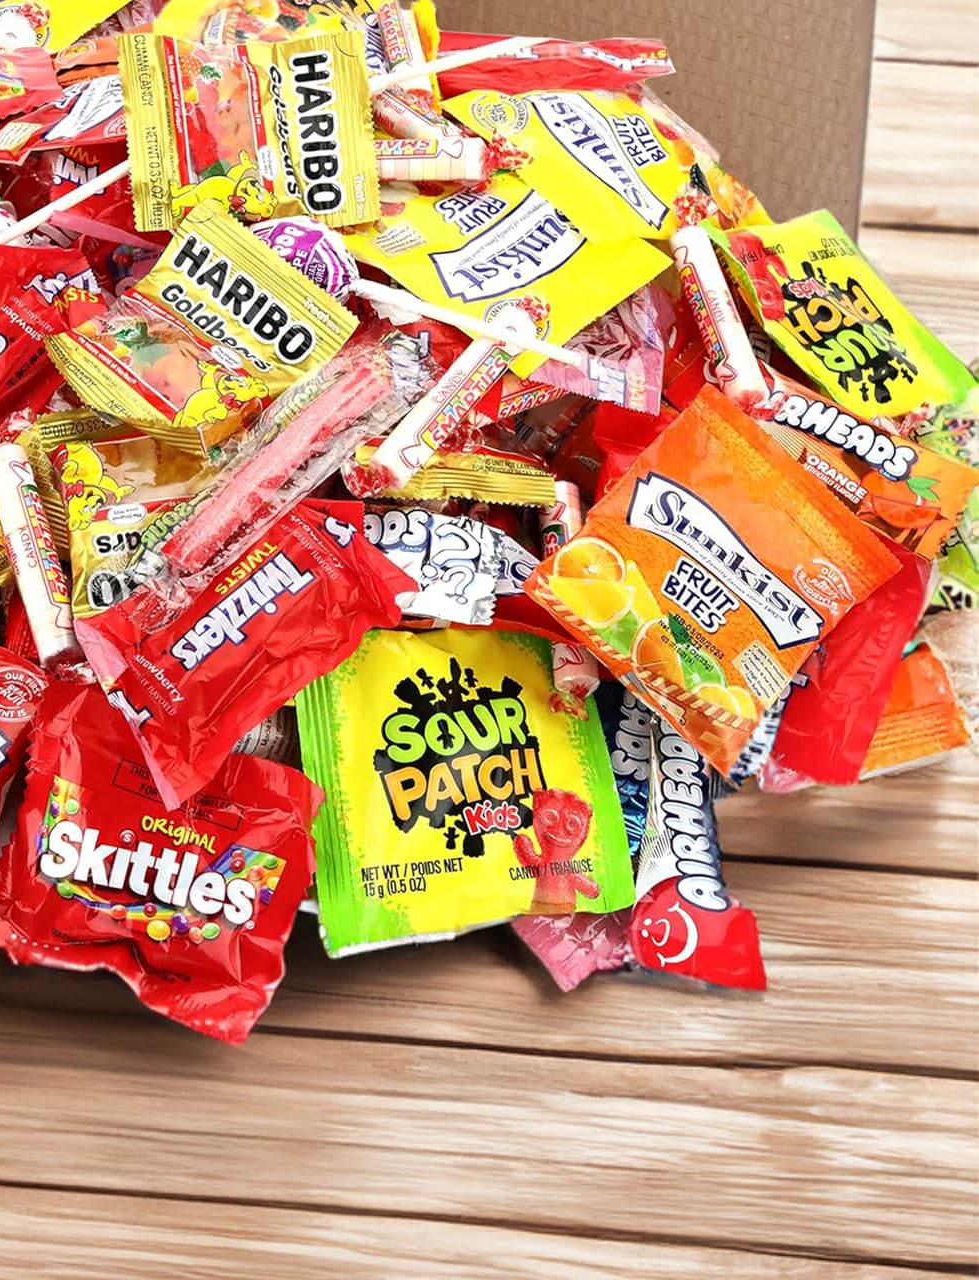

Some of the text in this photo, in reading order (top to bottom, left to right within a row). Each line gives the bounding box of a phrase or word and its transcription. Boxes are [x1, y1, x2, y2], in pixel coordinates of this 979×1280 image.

[379, 3, 402, 63] SMARTIES
[138, 73, 153, 106] CANDY
[291, 53, 342, 213] HARIBO
[375, 139, 431, 151] SMAR
[535, 93, 651, 211] Sunkist
[613, 116, 646, 166] FRUIT
[626, 116, 667, 163] BITES
[457, 195, 507, 234] FRUIT
[172, 234, 315, 361] HARIBO
[303, 297, 328, 321] Treat
[784, 284, 883, 346] PATCH
[161, 282, 273, 371] Goldbears
[430, 355, 509, 444] SMARTIES
[431, 367, 467, 406] CANDY
[806, 454, 869, 499] ORANGE
[832, 482, 861, 505] FLAVORED
[19, 526, 39, 569] CANDY
[28, 491, 69, 597] SMARTIES
[214, 540, 278, 595] TWISTS
[646, 489, 810, 634] Sunkist
[676, 558, 735, 612] FRUIT
[821, 566, 839, 582] OUR
[171, 550, 315, 671] Twizzlers
[663, 574, 722, 630] BITES
[4, 672, 42, 698] OUR FIRST
[5, 683, 28, 697] REAL
[133, 653, 185, 703] strawberry
[15, 709, 27, 718] IS
[385, 696, 528, 765] SOUR
[130, 764, 151, 780] THIS
[139, 782, 159, 797] FOR
[383, 748, 545, 820] PATCH
[465, 802, 521, 835] Kids
[659, 728, 727, 912] AIRHEAD
[39, 819, 257, 926] Skittles
[361, 866, 380, 882] NET
[381, 864, 401, 880] WT
[410, 859, 442, 878] POIDS
[444, 856, 464, 873] NET
[362, 876, 427, 899] 15 g (0.5 OZ)
[508, 863, 541, 882] CANDY
